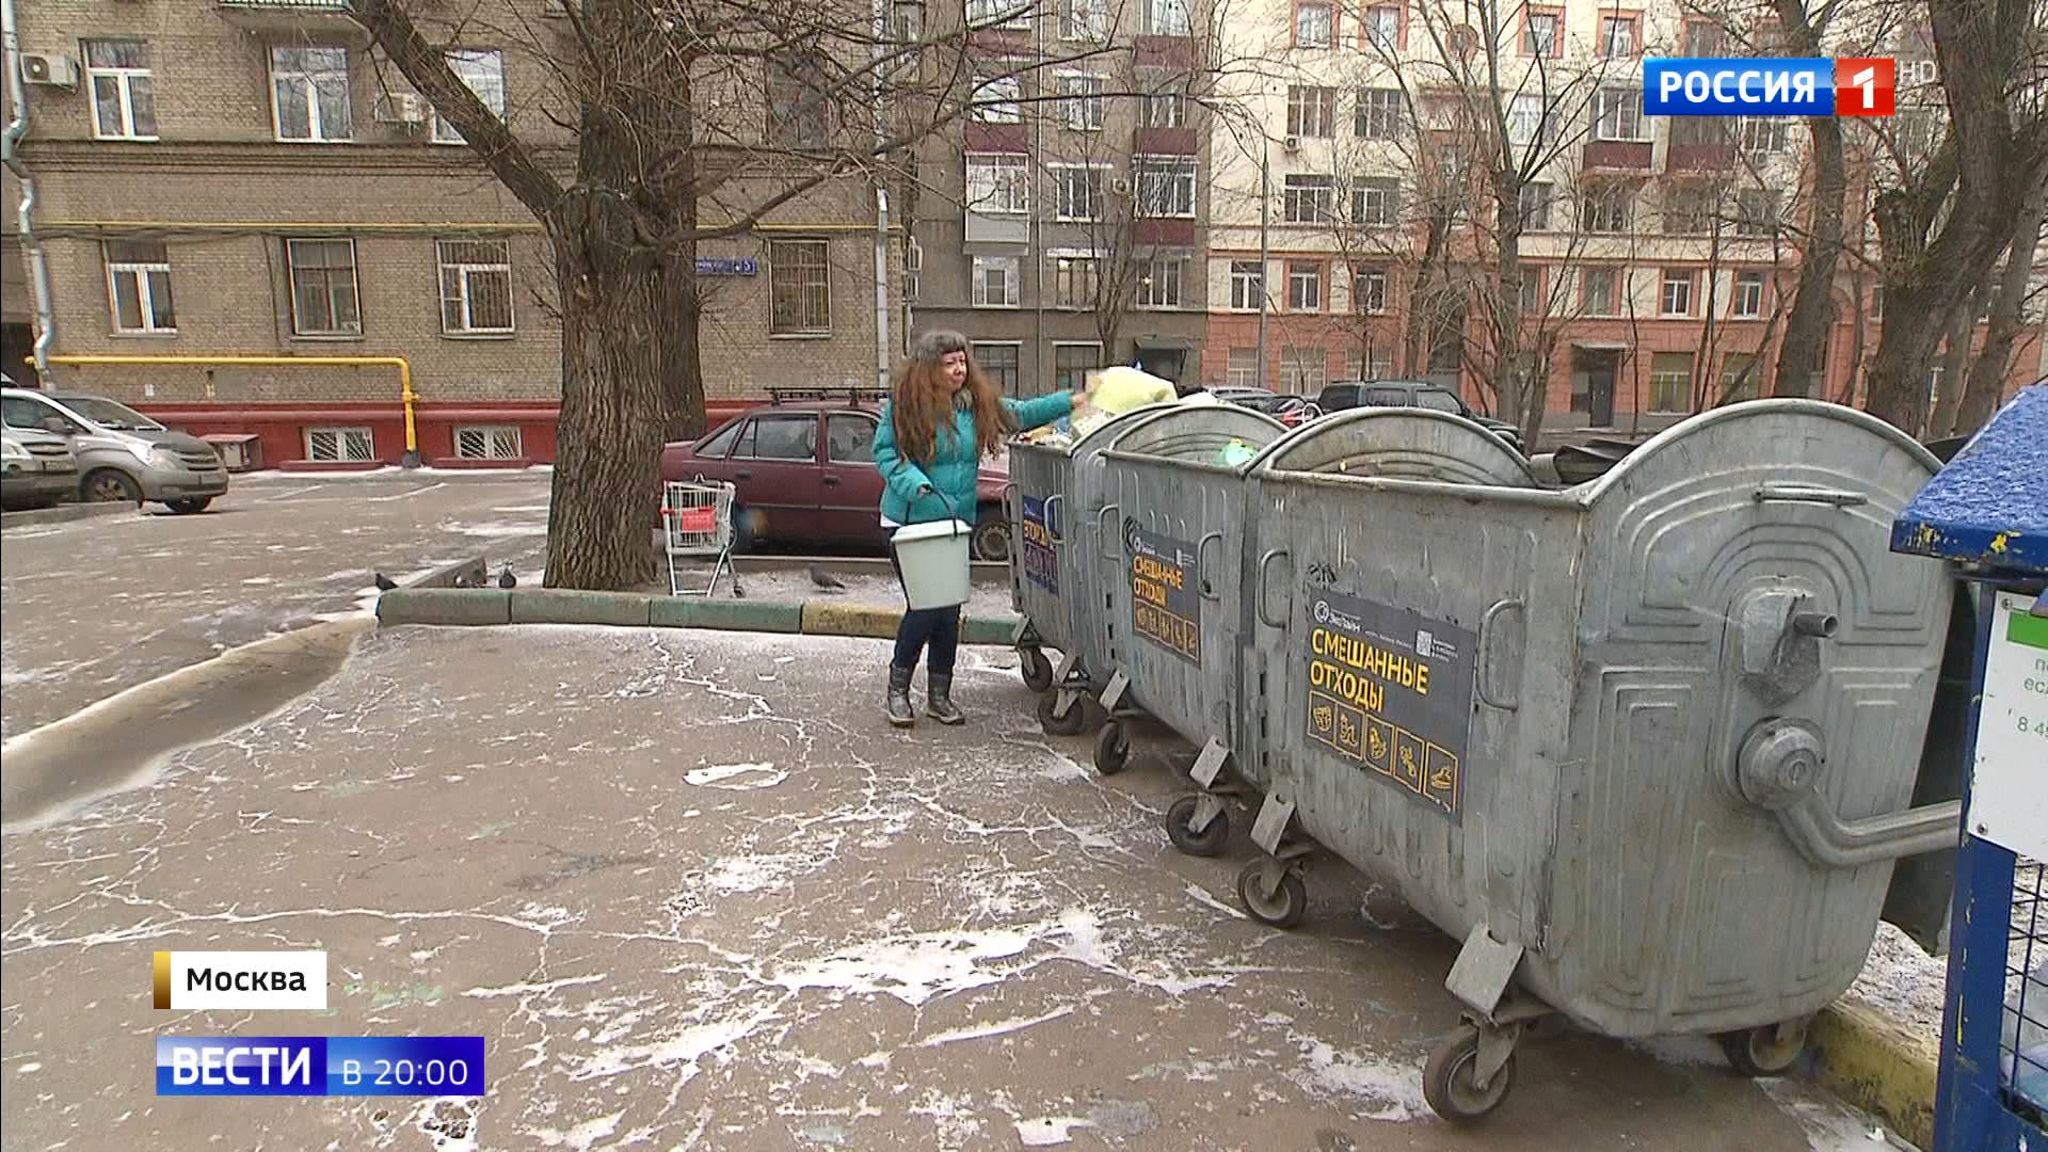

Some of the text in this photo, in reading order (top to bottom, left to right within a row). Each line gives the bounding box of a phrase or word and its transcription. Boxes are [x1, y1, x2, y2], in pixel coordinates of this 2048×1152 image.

[1133, 556, 1183, 590] СМЕШАННЫЕ
[1133, 578, 1167, 607] ОТХОДЫ
[1311, 628, 1430, 695] СМЕШАННЫЕ
[2035, 658, 2048, 671] п
[1310, 660, 1384, 712] ОТХОДЫ
[2017, 716, 2029, 732] 8
